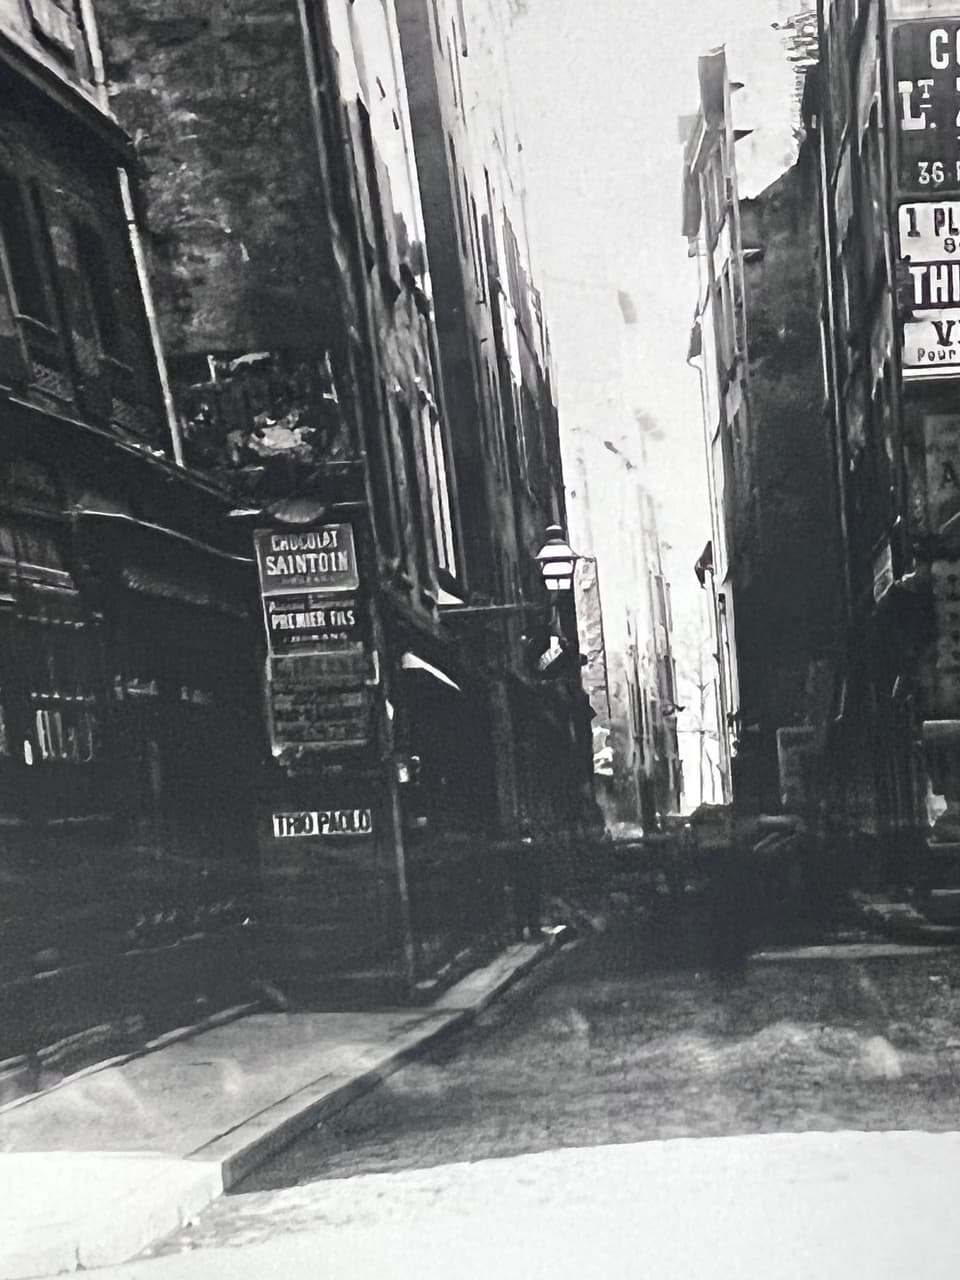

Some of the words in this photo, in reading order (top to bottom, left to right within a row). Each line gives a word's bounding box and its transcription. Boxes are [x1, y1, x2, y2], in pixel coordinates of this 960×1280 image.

[917, 161, 944, 184] 36
[906, 207, 921, 238] 1
[917, 347, 956, 363] Pour
[265, 550, 348, 576] SAINTOIN
